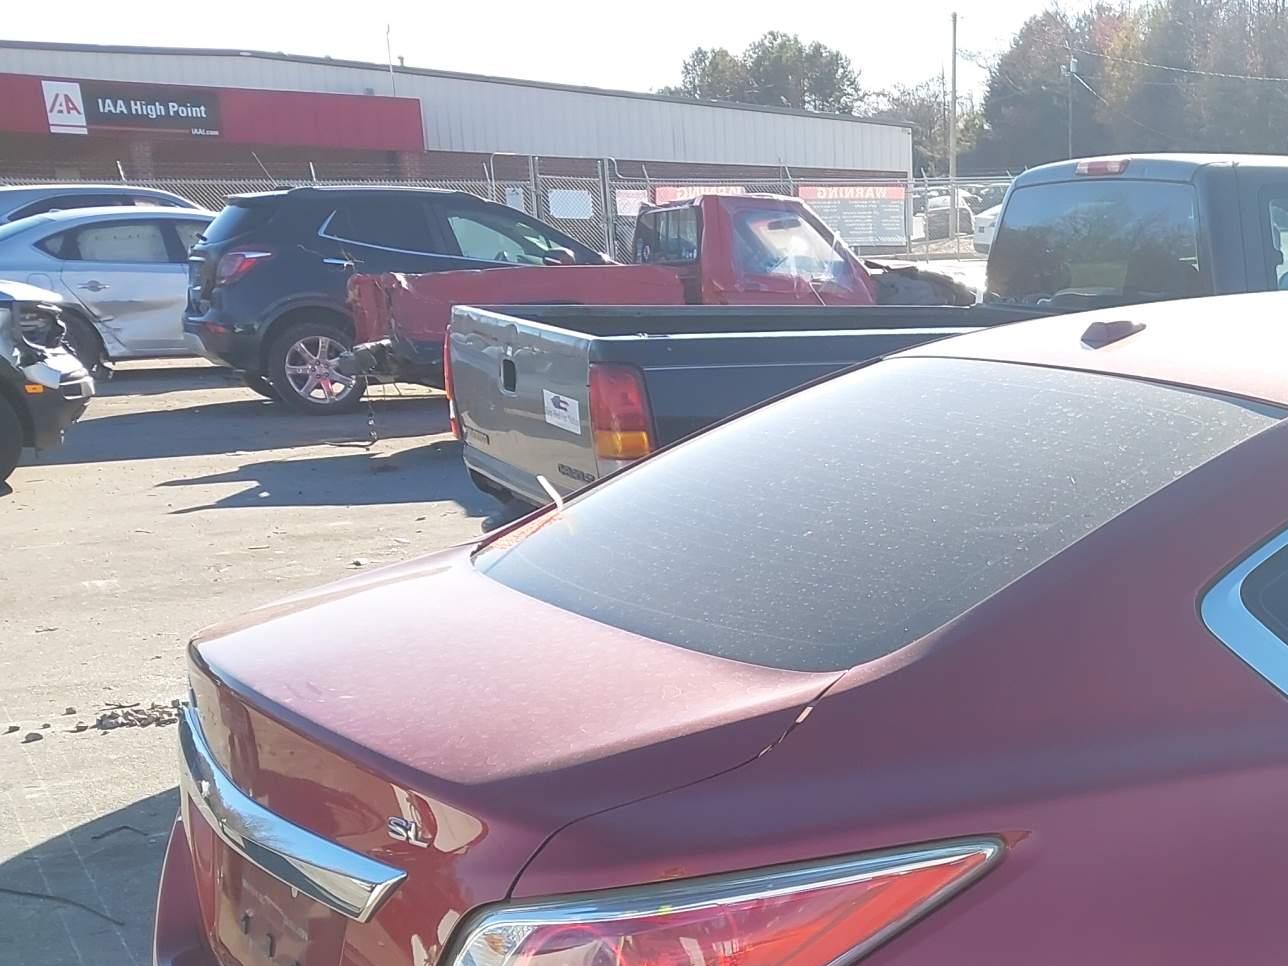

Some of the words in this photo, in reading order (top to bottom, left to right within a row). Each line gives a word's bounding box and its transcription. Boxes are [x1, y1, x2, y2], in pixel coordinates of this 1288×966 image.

[97, 98, 128, 115] IAA
[131, 100, 166, 118] High
[168, 102, 208, 118] Point
[387, 815, 429, 849] SL
